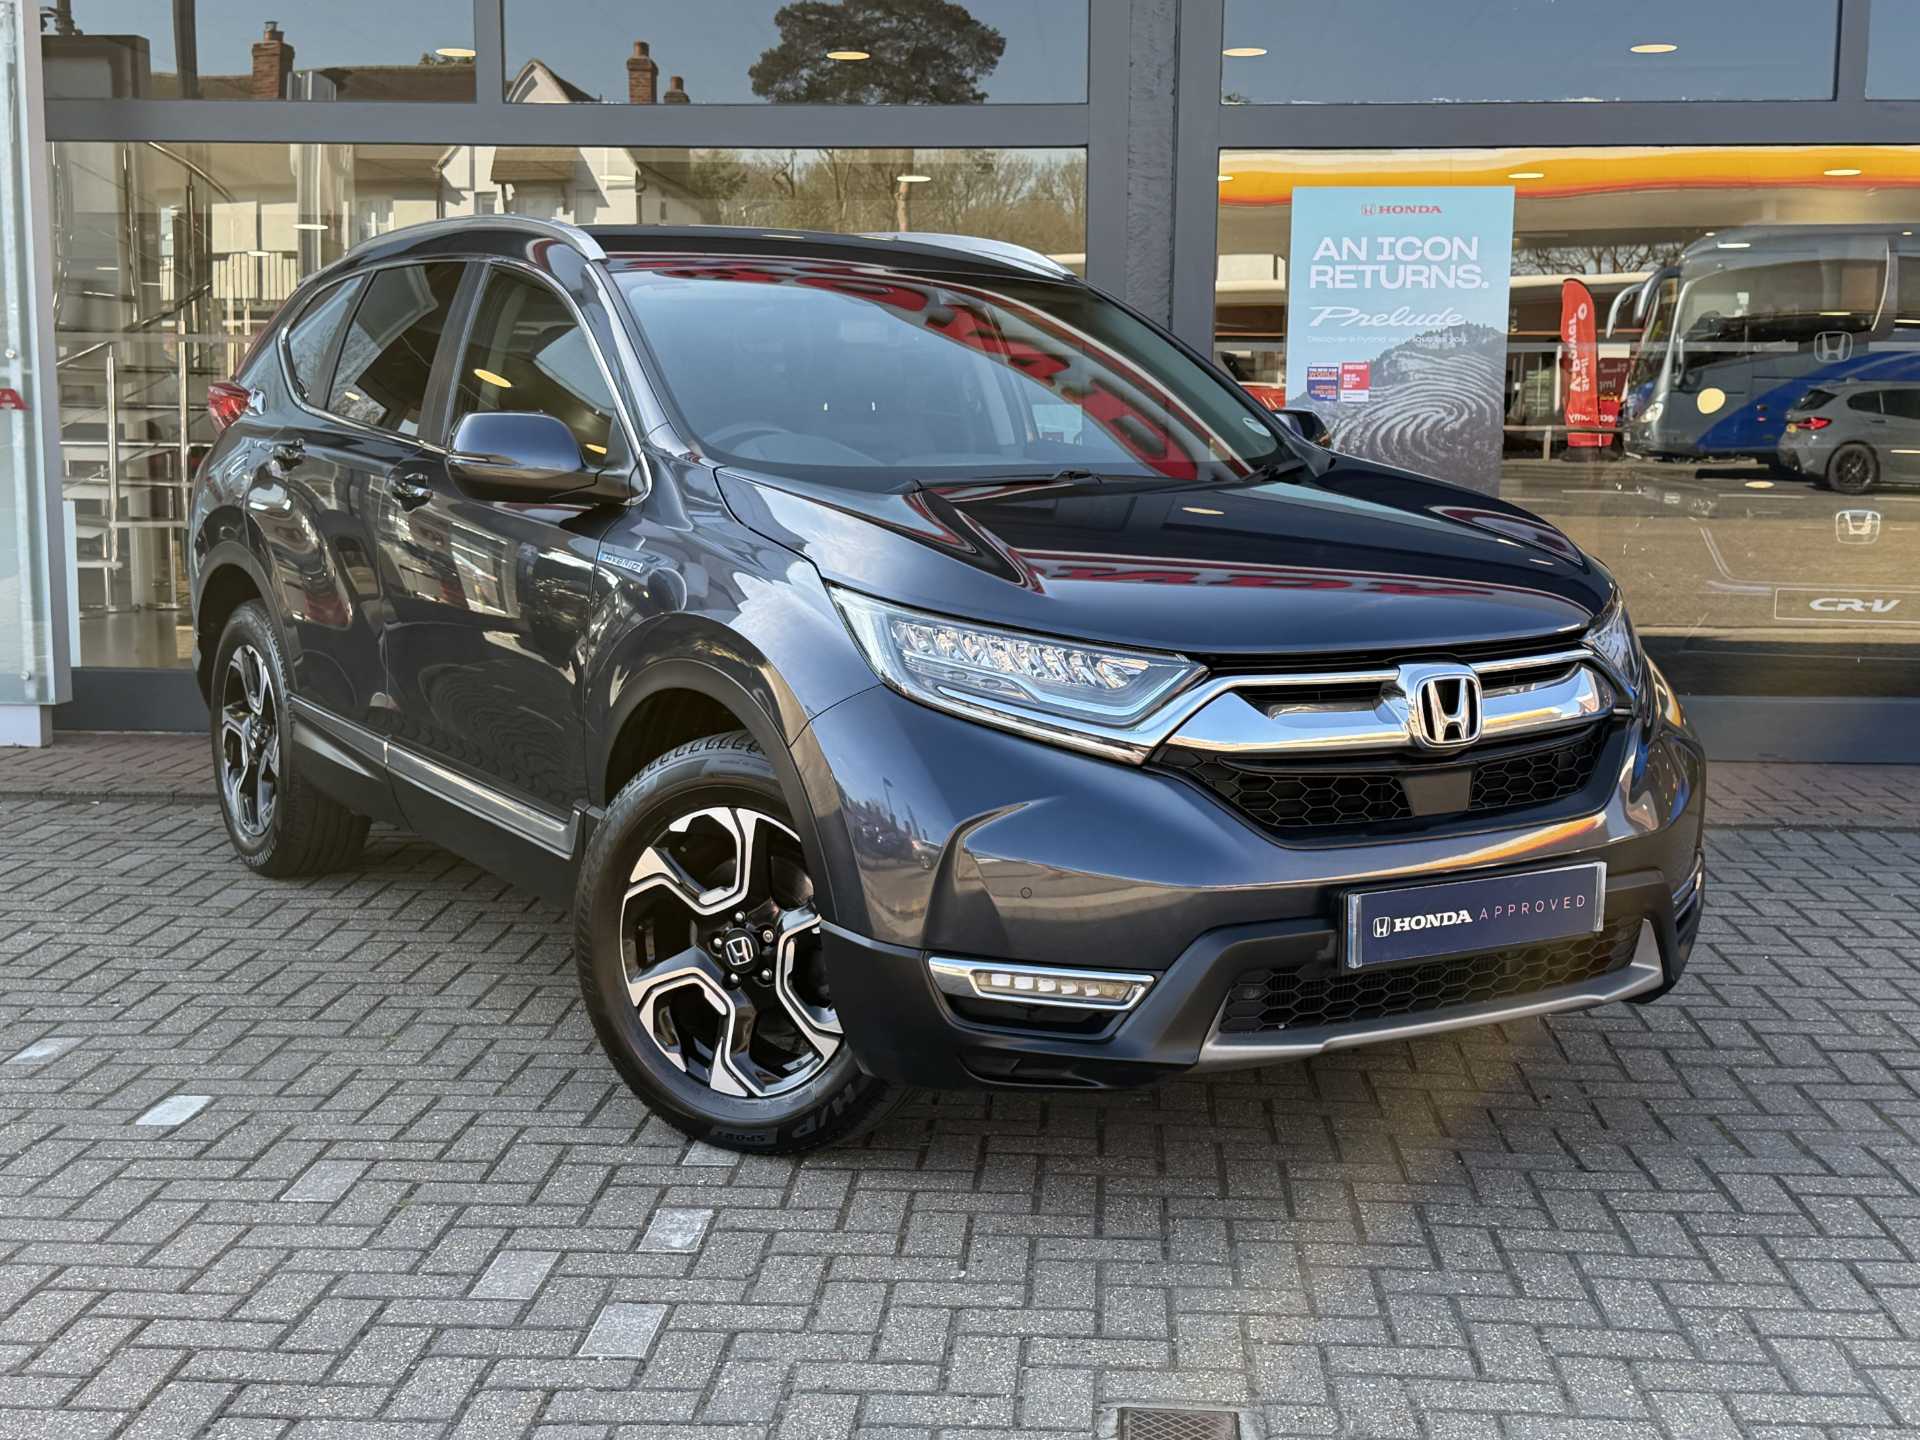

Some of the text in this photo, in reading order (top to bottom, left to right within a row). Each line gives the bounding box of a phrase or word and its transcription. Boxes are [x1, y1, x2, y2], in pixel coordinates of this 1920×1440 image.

[1379, 205, 1442, 214] HONDA
[1312, 236, 1479, 261] AN ICON
[1309, 264, 1489, 289] RETURNS.
[1308, 305, 1466, 328] Prelude
[1809, 597, 1901, 613] CR-V
[1393, 895, 1586, 932] HONDA APPROVED
